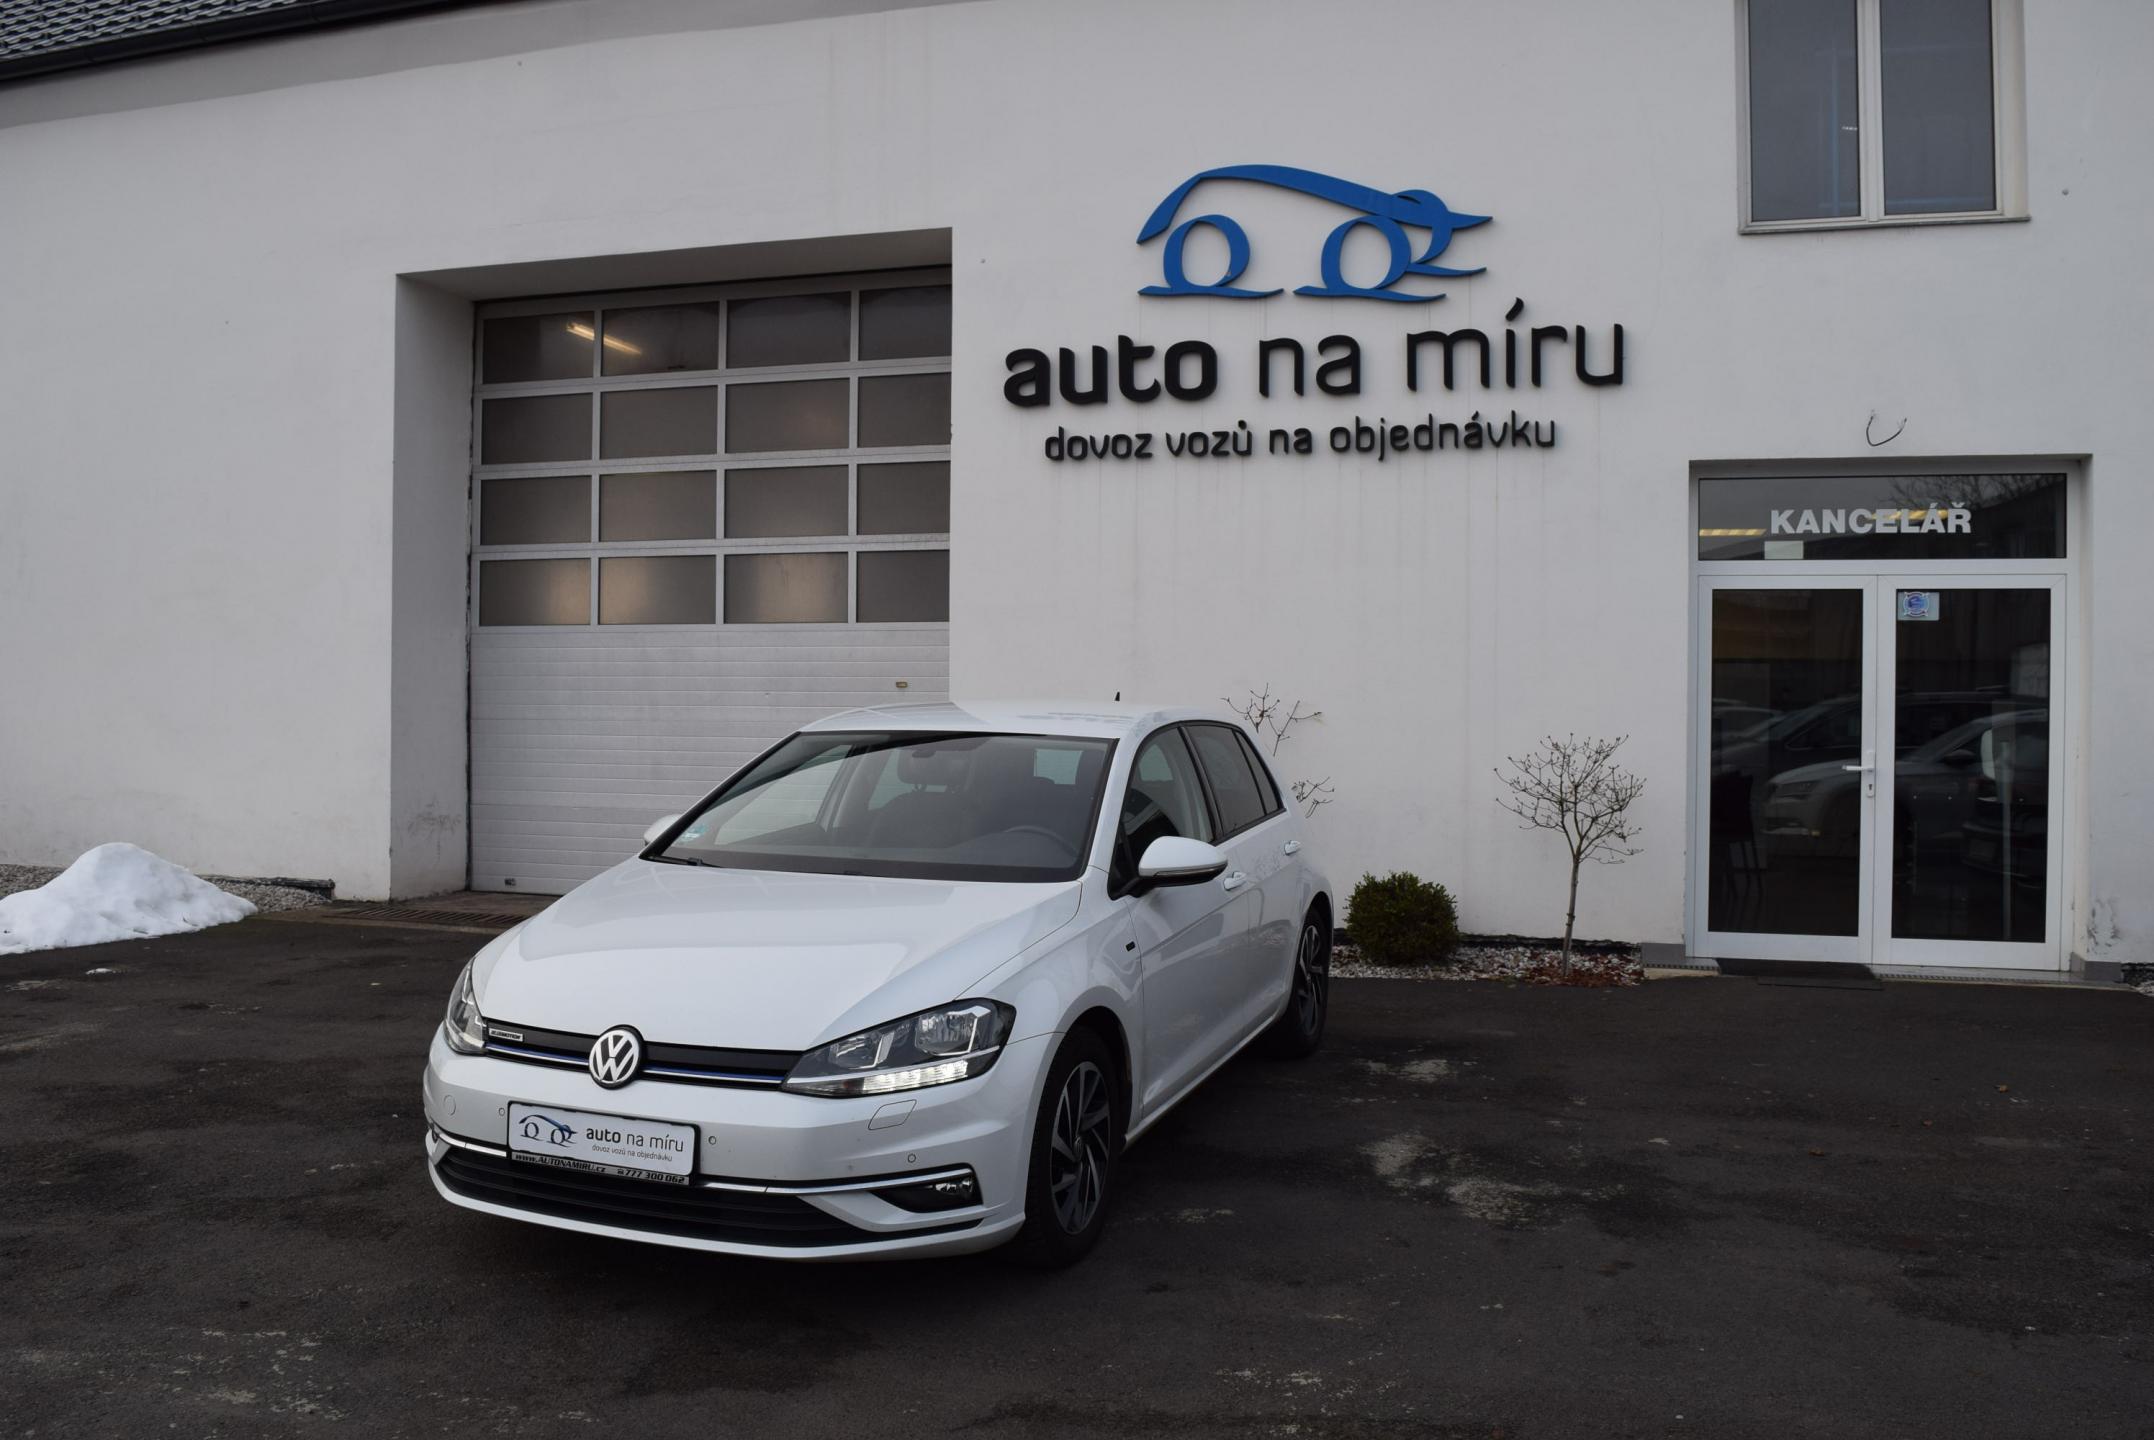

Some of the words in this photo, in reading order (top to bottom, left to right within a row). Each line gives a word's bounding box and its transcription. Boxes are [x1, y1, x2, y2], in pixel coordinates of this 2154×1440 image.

[1003, 334, 1218, 407] auto
[1258, 334, 1361, 397] na
[1407, 297, 1624, 391] míru
[1045, 426, 1153, 461] dovoz
[1165, 420, 1252, 457] vozů
[1269, 427, 1312, 455] na
[1330, 410, 1555, 462] objednávku
[1770, 502, 1972, 534] KANCELÁŘ
[586, 1127, 621, 1144] auto
[626, 1133, 644, 1147] na
[649, 1134, 684, 1152] míru
[645, 1172, 664, 1182] 300
